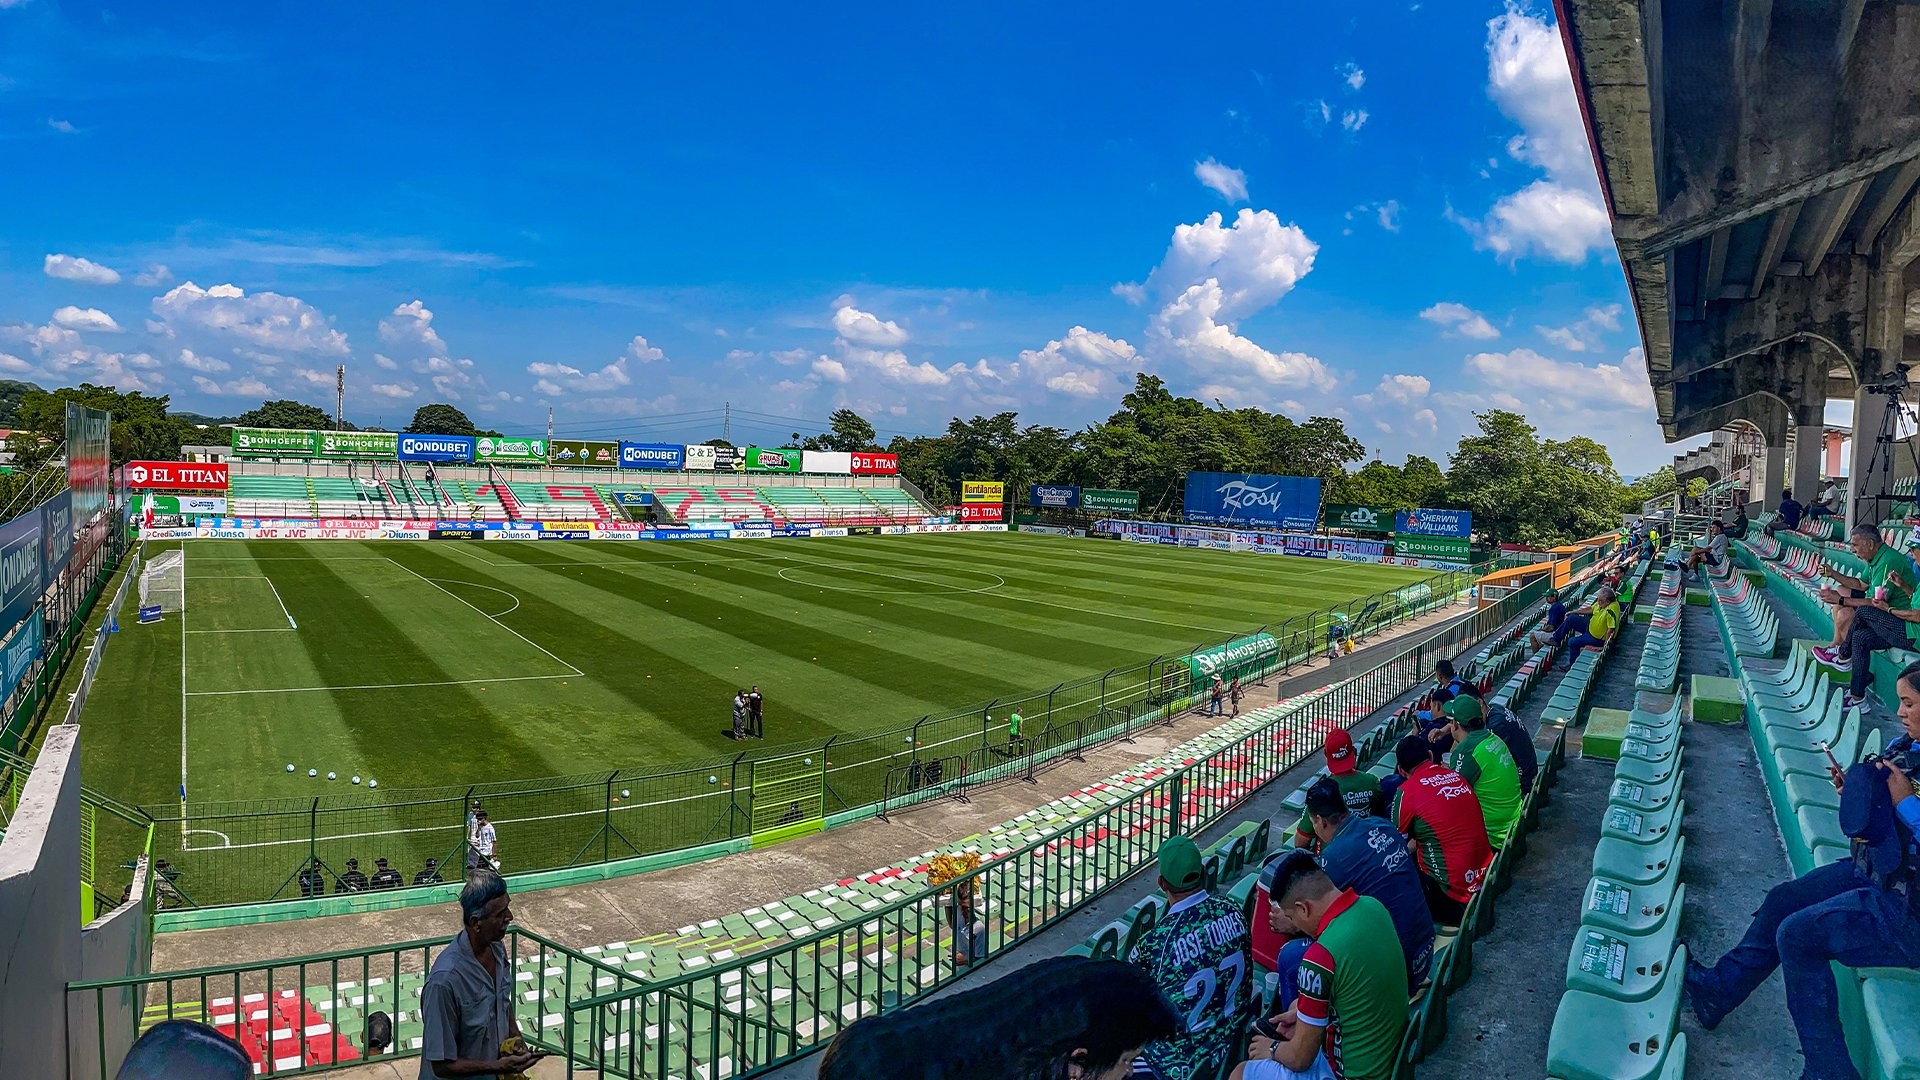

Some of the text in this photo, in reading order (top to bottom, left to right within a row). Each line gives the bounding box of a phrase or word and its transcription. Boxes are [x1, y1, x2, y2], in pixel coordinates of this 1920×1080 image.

[250, 437, 314, 446] BONHOEFFER
[335, 440, 397, 448] BONHOEFFER
[402, 438, 468, 455] HONDUBET
[624, 447, 678, 461] HONDUBET
[862, 458, 873, 469] EL
[874, 459, 897, 469] TITAN
[151, 468, 174, 482] EL
[178, 469, 227, 483] TITAN
[1092, 496, 1137, 505] BONHOEFFER
[1216, 480, 1281, 513] Rosy
[970, 507, 981, 517] EL
[981, 507, 1003, 517] TITAN
[1420, 512, 1460, 524] SHERWIN
[350, 521, 376, 529] TITAN
[1419, 521, 1460, 533] WILLIAMS
[209, 529, 245, 538] Diunsa
[255, 529, 307, 538] JVC JVC
[317, 529, 366, 539] JVC JVC
[388, 530, 420, 539] Diunsa
[501, 530, 531, 539] Diunsa
[604, 530, 632, 539] Diunsa
[742, 530, 766, 538] Diunsa
[1408, 543, 1470, 553] BONHOEFFER
[1341, 552, 1367, 562] Diunsa
[1378, 556, 1419, 567] JVC JVC
[2, 537, 39, 594] ONDUBET
[1209, 637, 1277, 665] BONHOEFFER
[1346, 796, 1370, 806] GISTICS
[1172, 911, 1246, 967] JOSE TORRES
[1297, 965, 1322, 996] NSA
[1183, 950, 1246, 1032] 27
